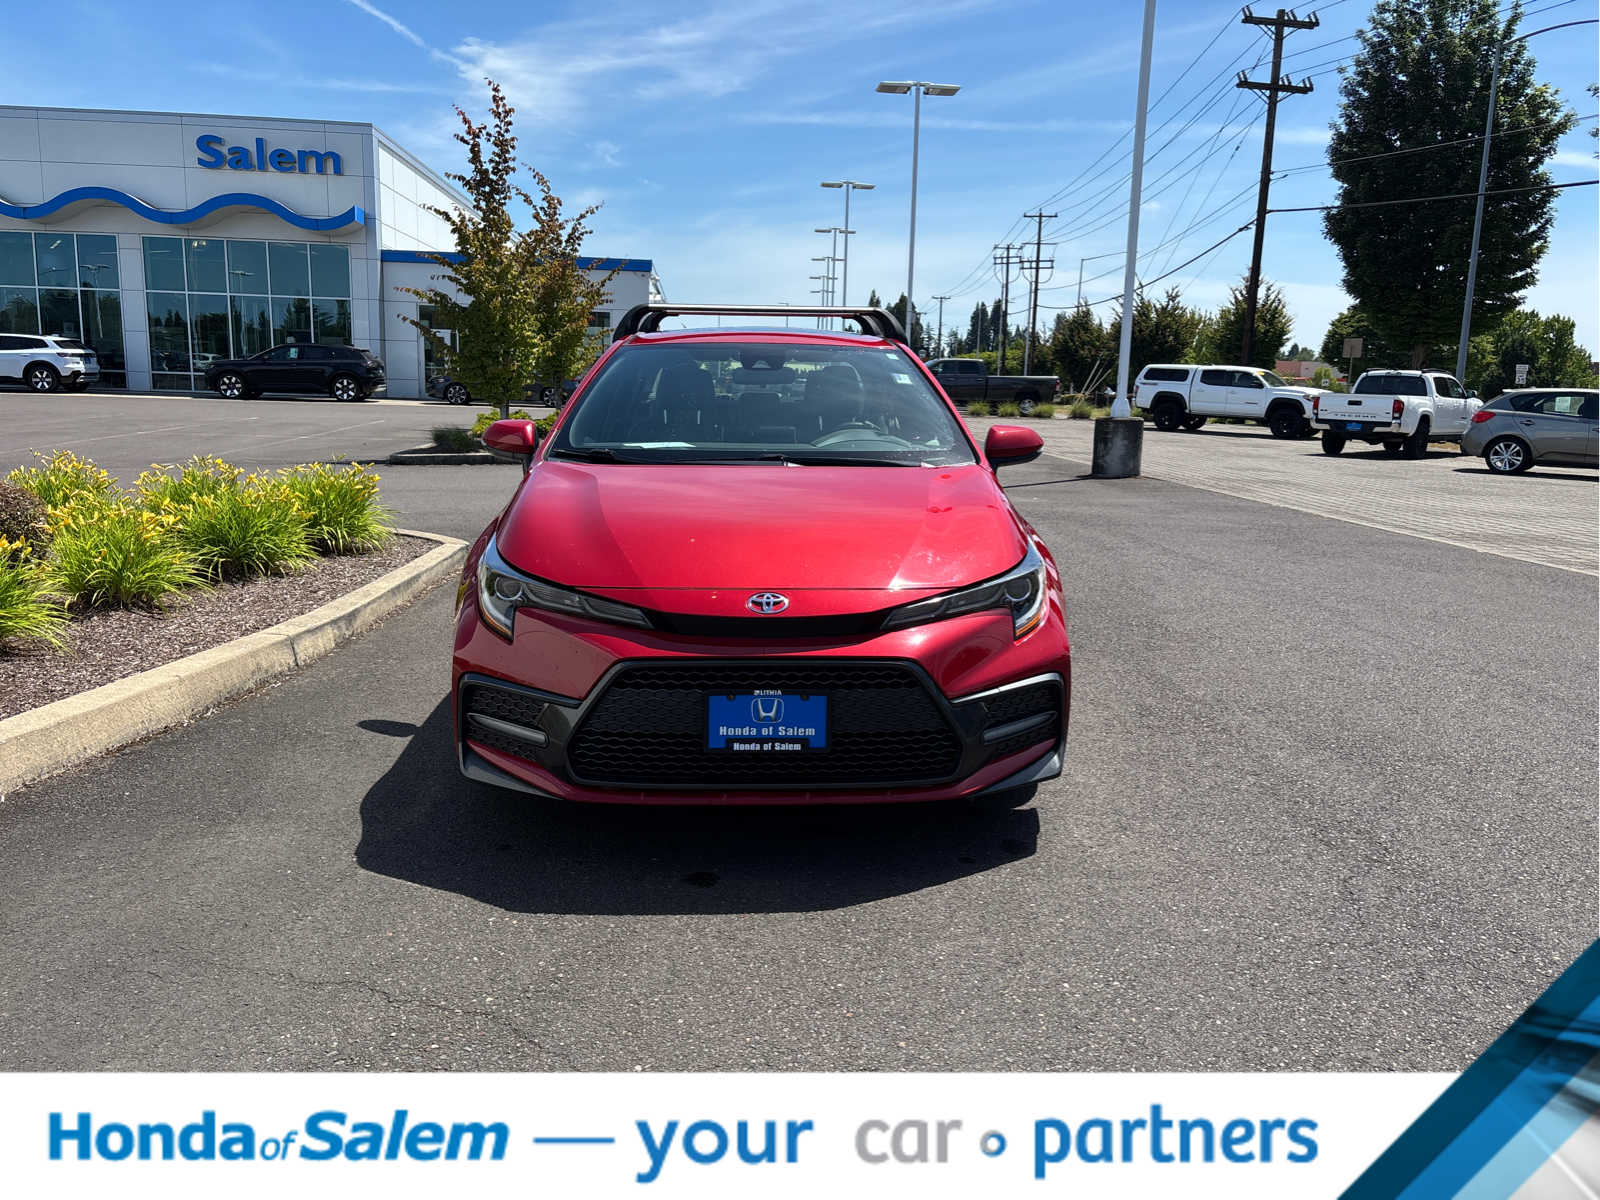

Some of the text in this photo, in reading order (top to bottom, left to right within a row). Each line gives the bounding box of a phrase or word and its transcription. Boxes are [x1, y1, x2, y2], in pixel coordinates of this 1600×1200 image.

[196, 134, 343, 175] Salem
[719, 726, 816, 736] Honda of Salem
[733, 742, 802, 751] Honda of Salem
